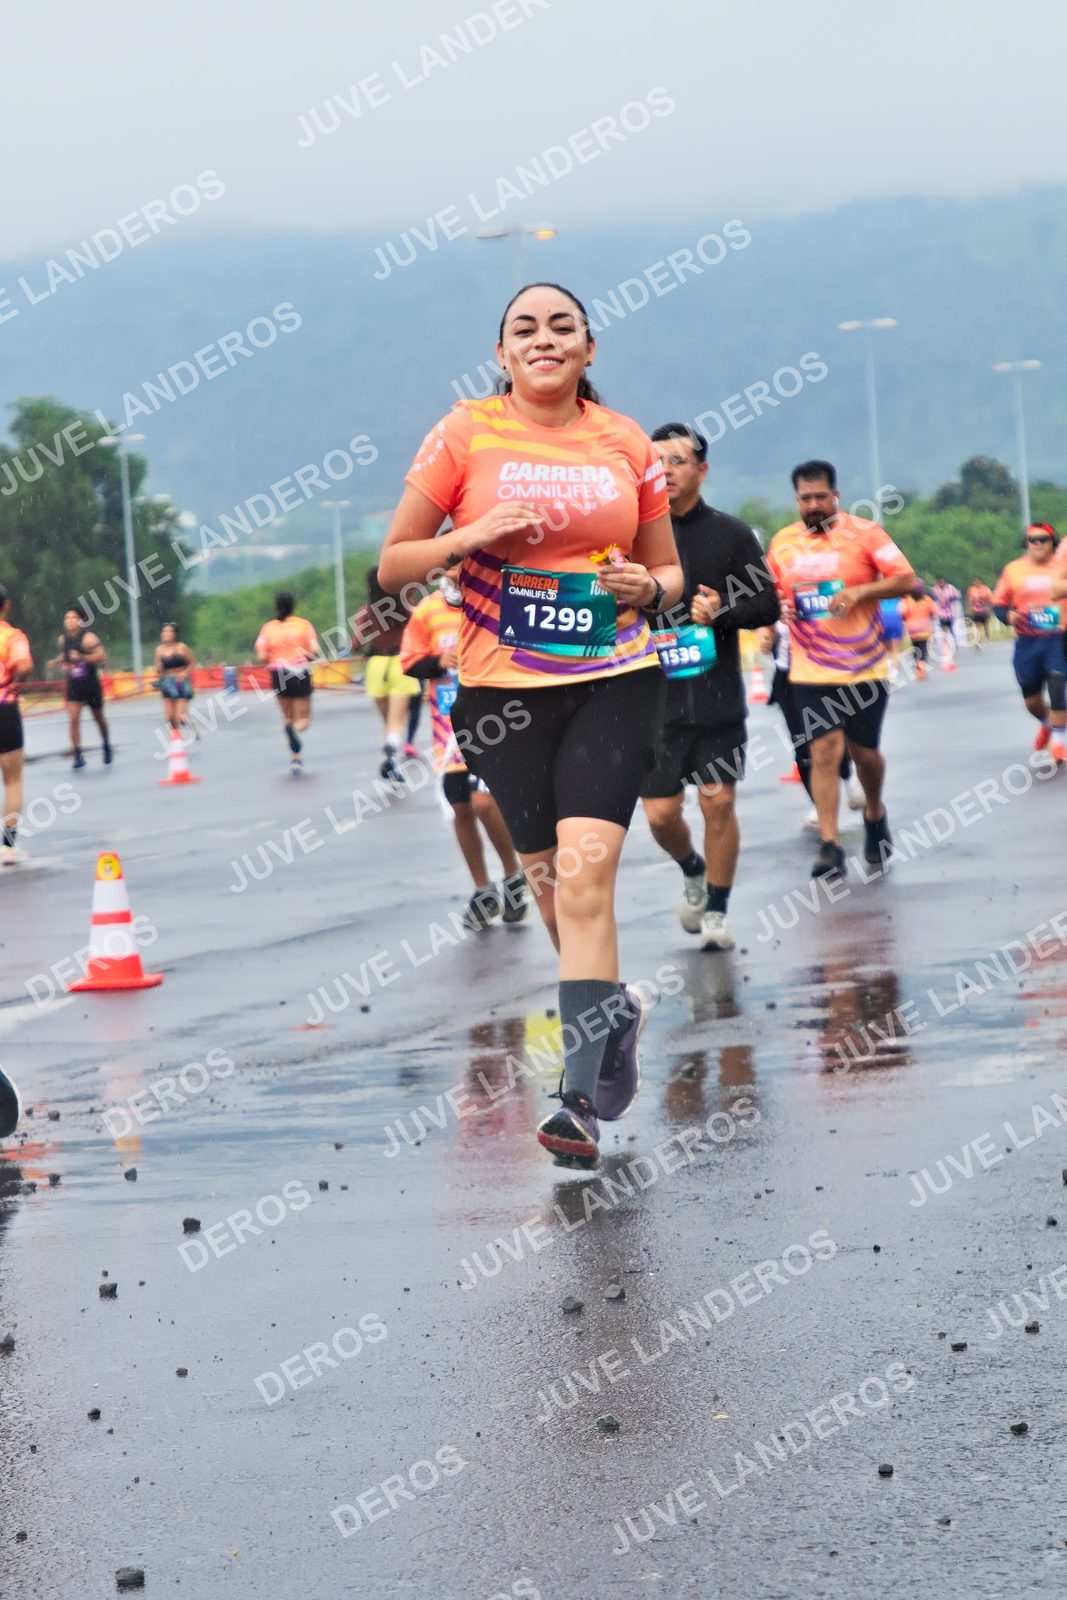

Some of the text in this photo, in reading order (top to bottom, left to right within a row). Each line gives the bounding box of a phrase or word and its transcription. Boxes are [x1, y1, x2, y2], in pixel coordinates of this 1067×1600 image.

[498, 461, 615, 485] CARRERA
[497, 484, 594, 499] OMNILIFE
[510, 573, 559, 590] CARRERA
[508, 586, 546, 599] OMNILIFE
[524, 603, 593, 632] 1299
[660, 645, 701, 665] 1536
